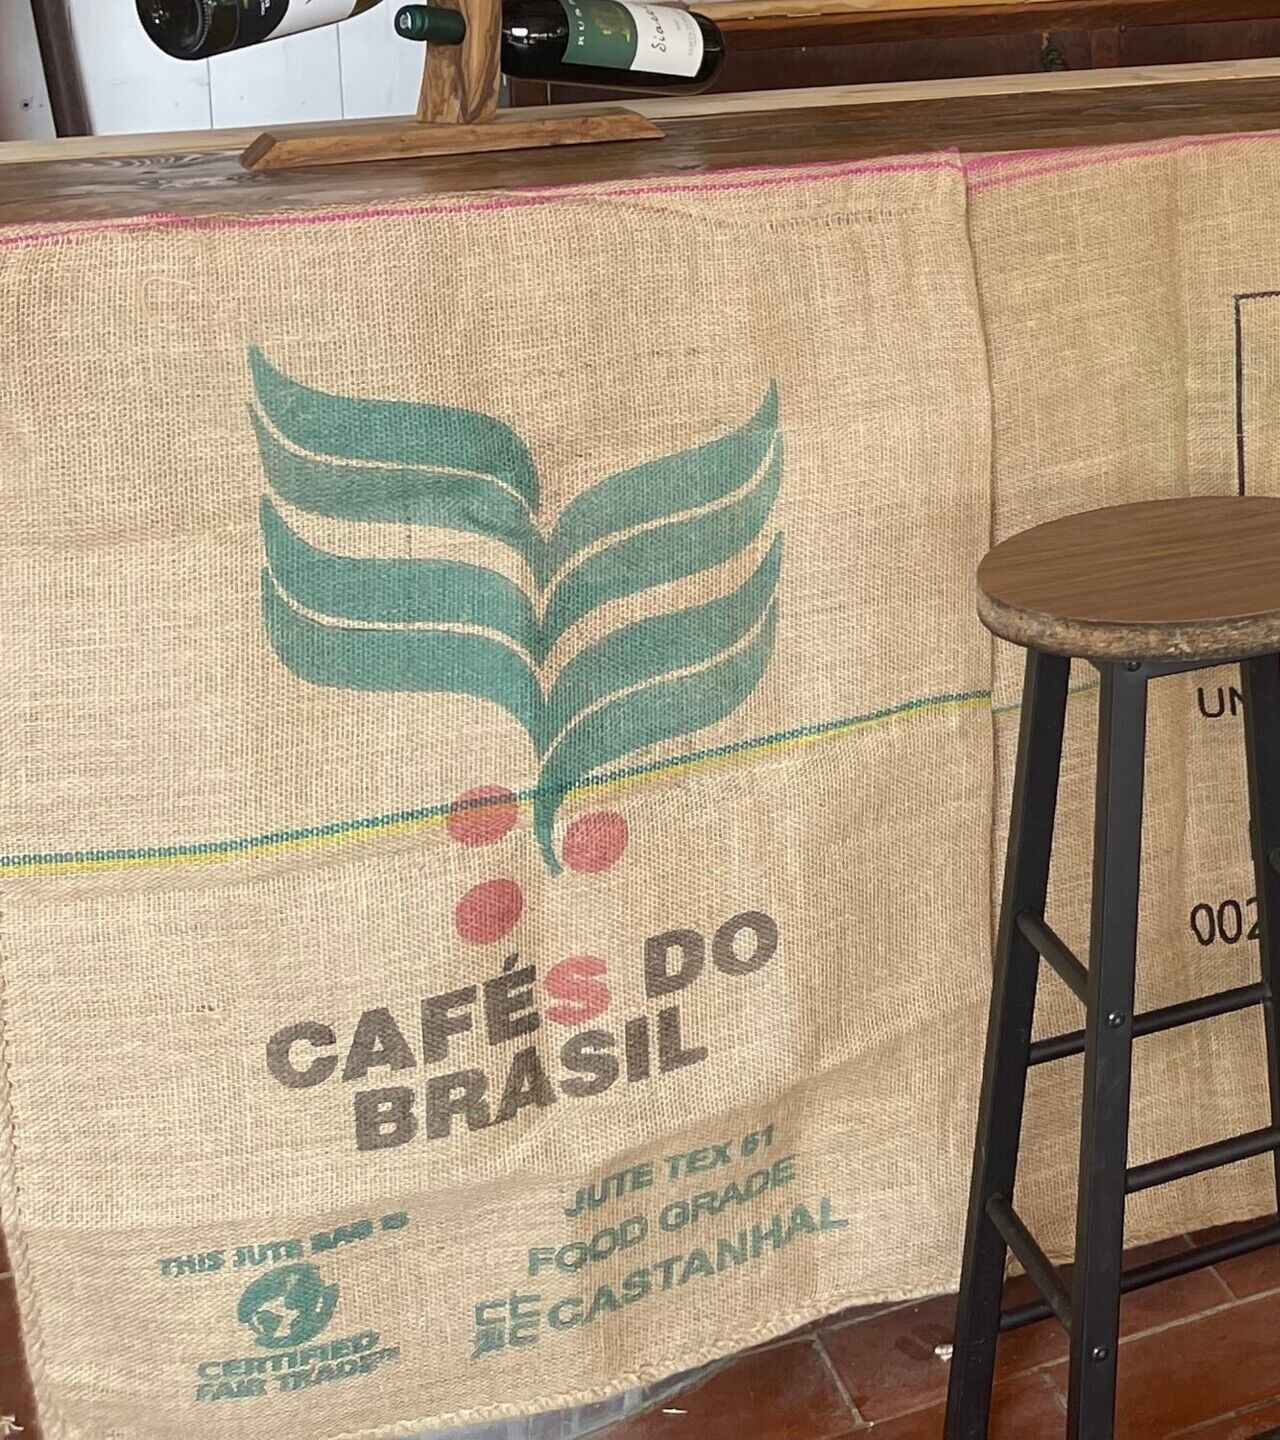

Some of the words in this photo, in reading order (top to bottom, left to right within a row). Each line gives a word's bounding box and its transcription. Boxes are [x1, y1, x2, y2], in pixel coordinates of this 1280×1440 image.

[265, 952, 612, 1090] CAFÉS
[644, 910, 779, 998] DO
[354, 1006, 709, 1152] BRASIL
[527, 1215, 649, 1277] FOOD
[658, 1153, 800, 1234] GRADE
[564, 1162, 652, 1218] JUTE
[664, 1140, 733, 1182] TEX
[549, 1196, 850, 1332] CASTANHAL
